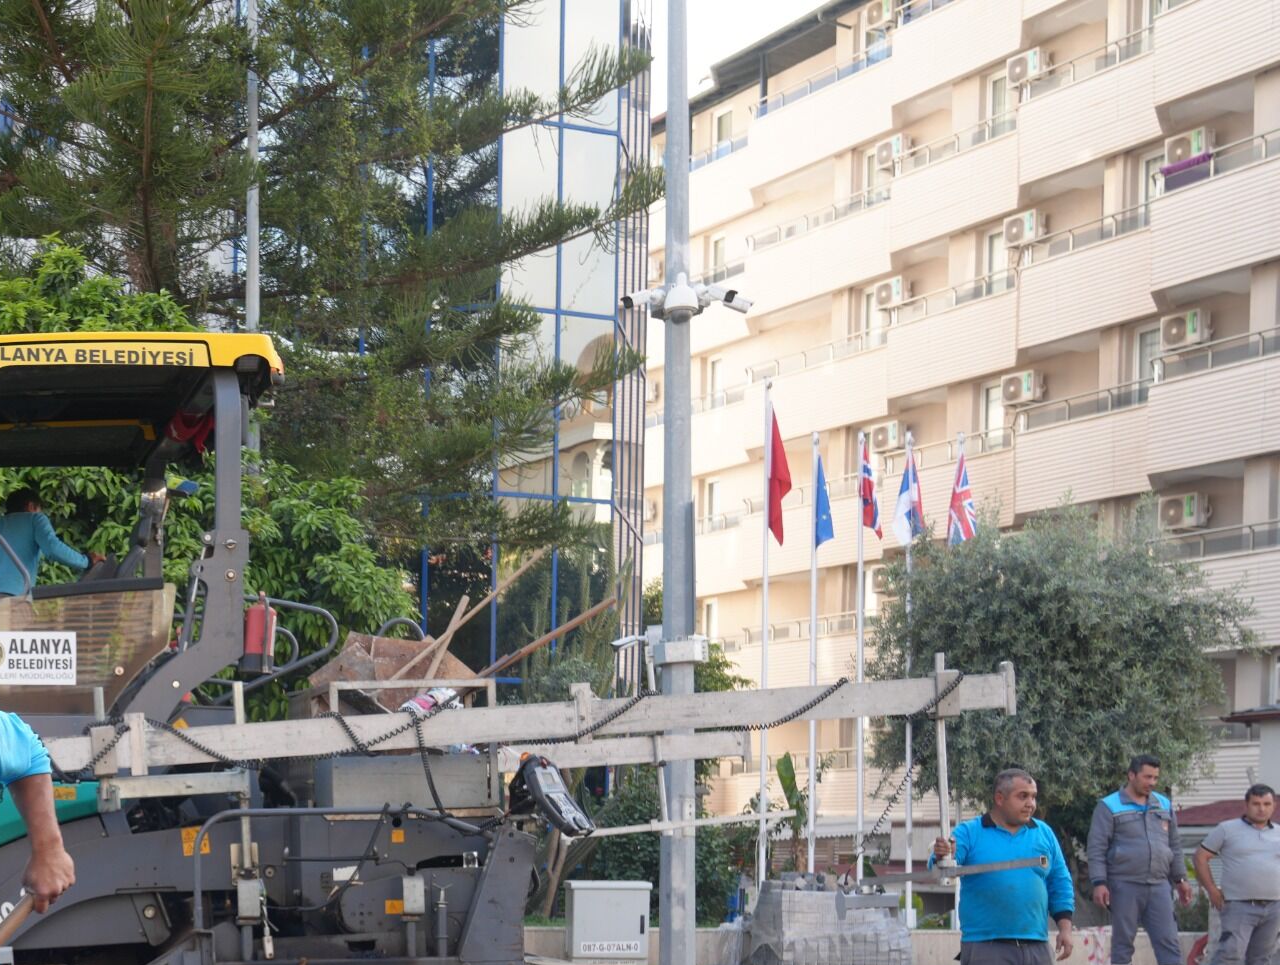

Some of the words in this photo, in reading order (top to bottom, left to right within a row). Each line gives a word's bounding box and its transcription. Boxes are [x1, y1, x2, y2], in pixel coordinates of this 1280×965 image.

[75, 347, 194, 366] BELEDİYESİ
[8, 638, 72, 655] ALANYA
[8, 657, 73, 670] BELEDİYESİ
